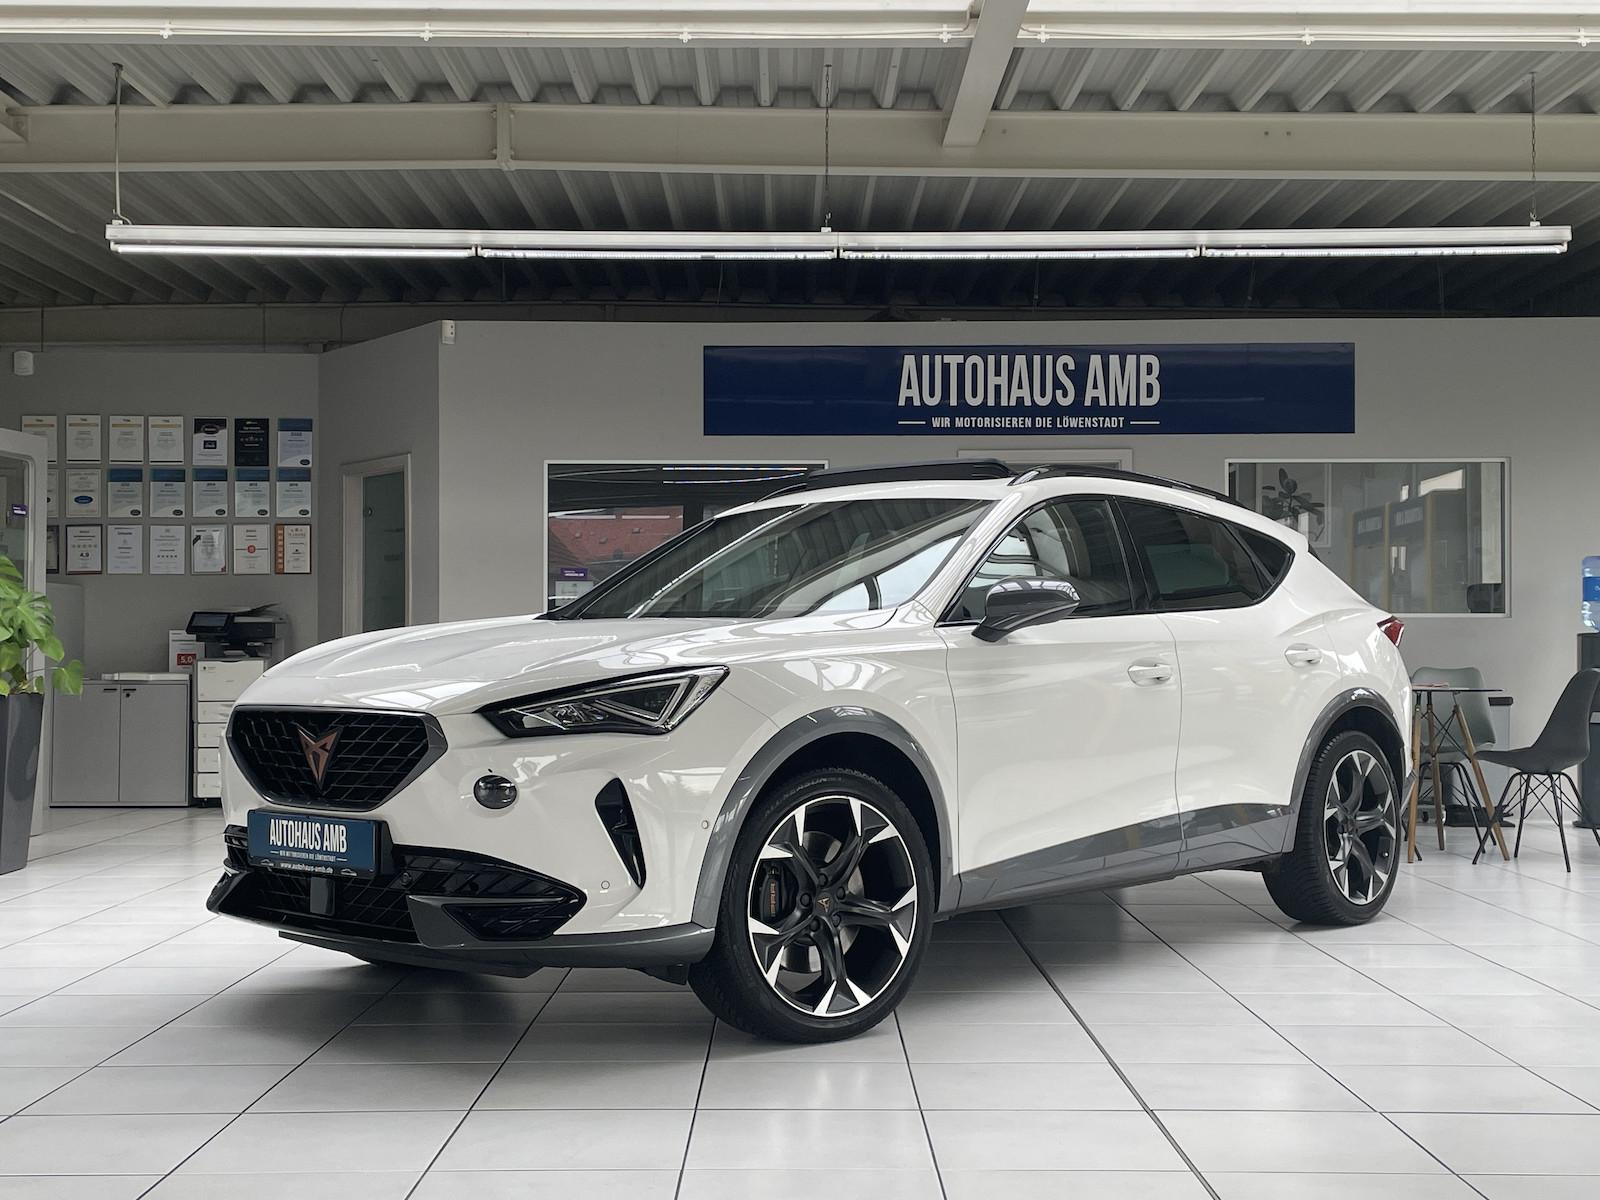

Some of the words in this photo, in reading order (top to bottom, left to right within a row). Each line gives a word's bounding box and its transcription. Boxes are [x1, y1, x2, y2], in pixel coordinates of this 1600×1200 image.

[897, 354, 1075, 407] AUTOHAUS
[1084, 354, 1162, 407] AMB
[931, 416, 951, 428] WIR
[955, 416, 1032, 428] MOTORISIEREN
[1035, 416, 1053, 428] DIE
[1056, 414, 1125, 428] LÖWENSTADT
[269, 818, 321, 851] AUTOHAUS
[323, 824, 348, 853] AMB
